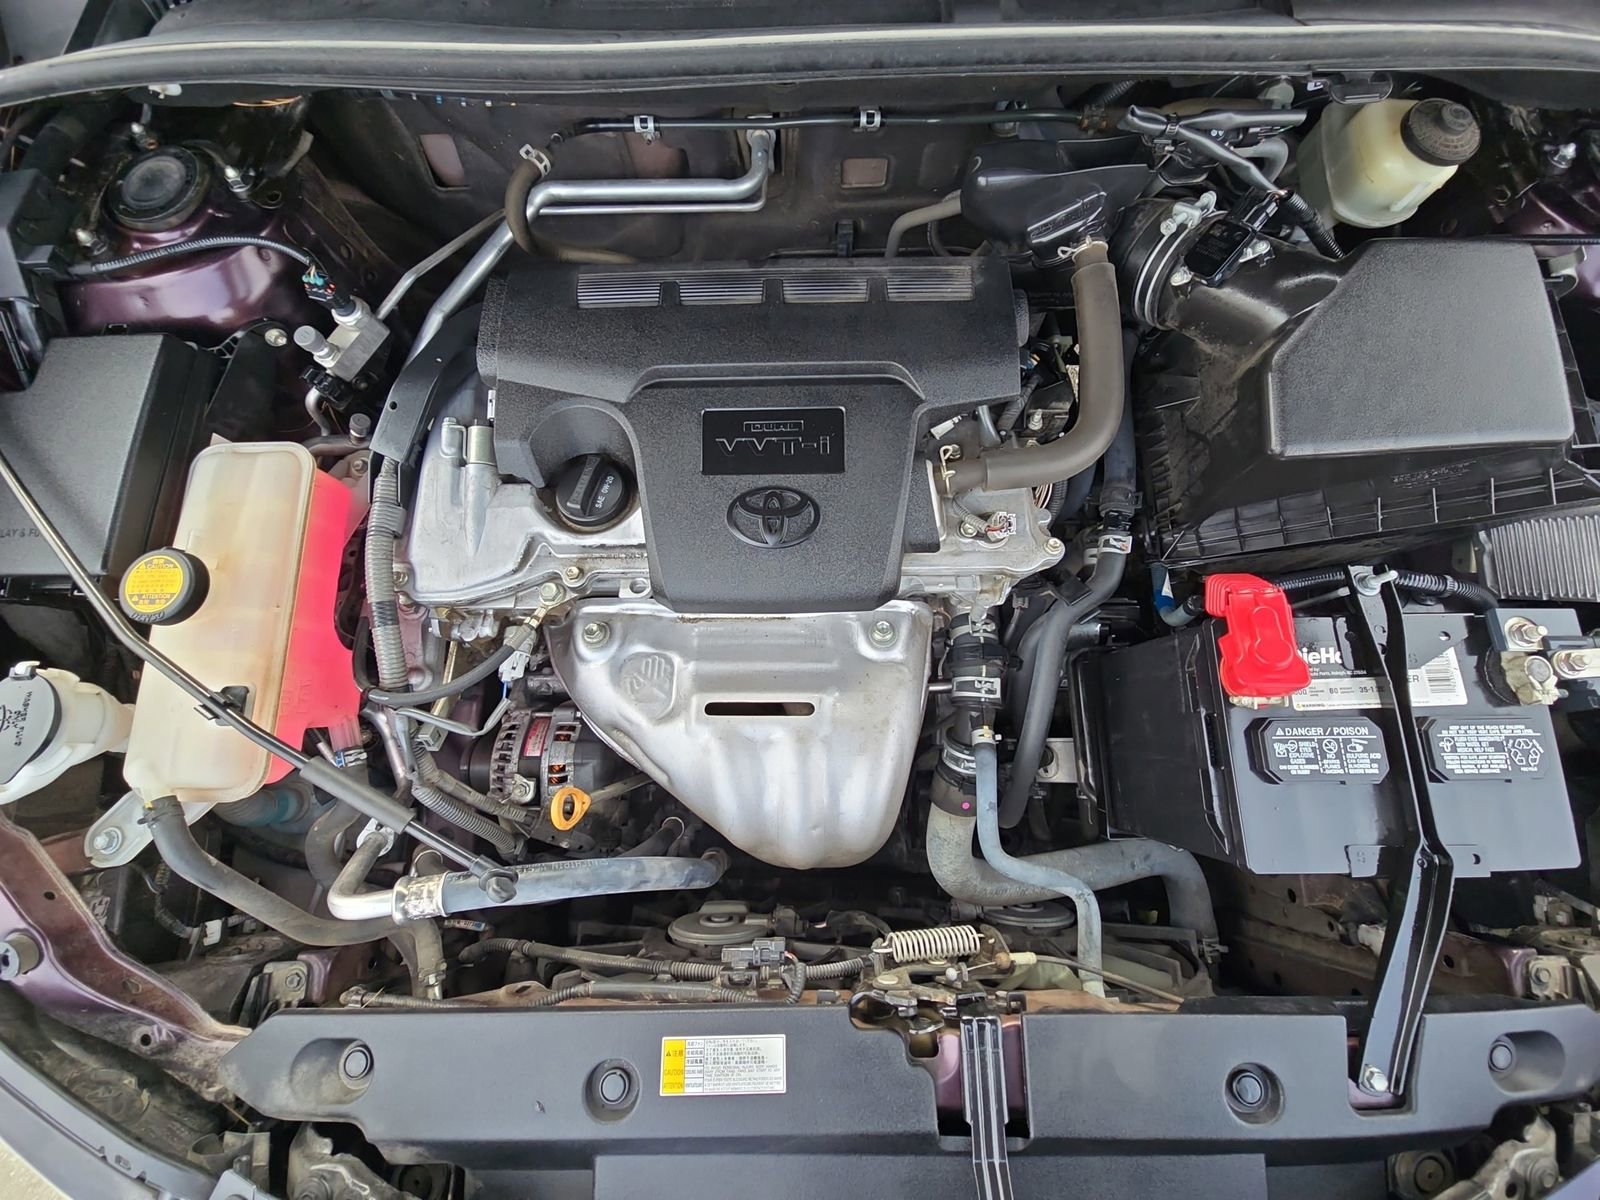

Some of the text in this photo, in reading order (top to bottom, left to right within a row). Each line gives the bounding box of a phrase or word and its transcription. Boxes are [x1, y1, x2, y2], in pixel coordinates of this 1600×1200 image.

[750, 422, 800, 432] DUAL
[715, 435, 830, 456] VVT-i
[595, 475, 615, 509] SAE 0W-20
[1284, 726, 1369, 736] DANGER / POISON
